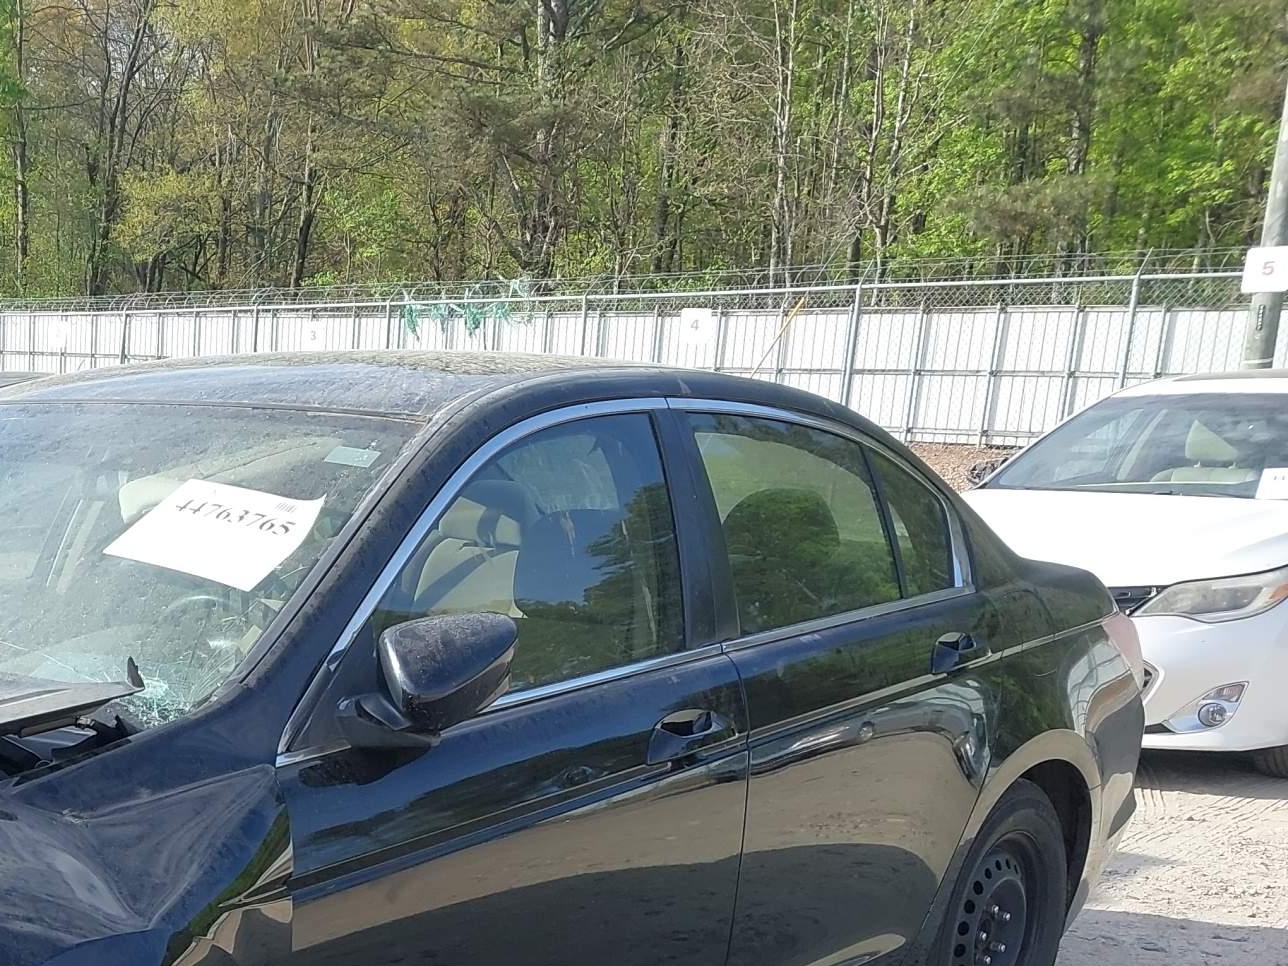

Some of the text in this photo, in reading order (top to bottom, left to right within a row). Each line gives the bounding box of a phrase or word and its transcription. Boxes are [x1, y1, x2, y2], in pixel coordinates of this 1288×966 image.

[1262, 261, 1276, 276] 5
[690, 319, 700, 331] 4
[310, 330, 317, 341] 3
[175, 499, 297, 535] 44763765
